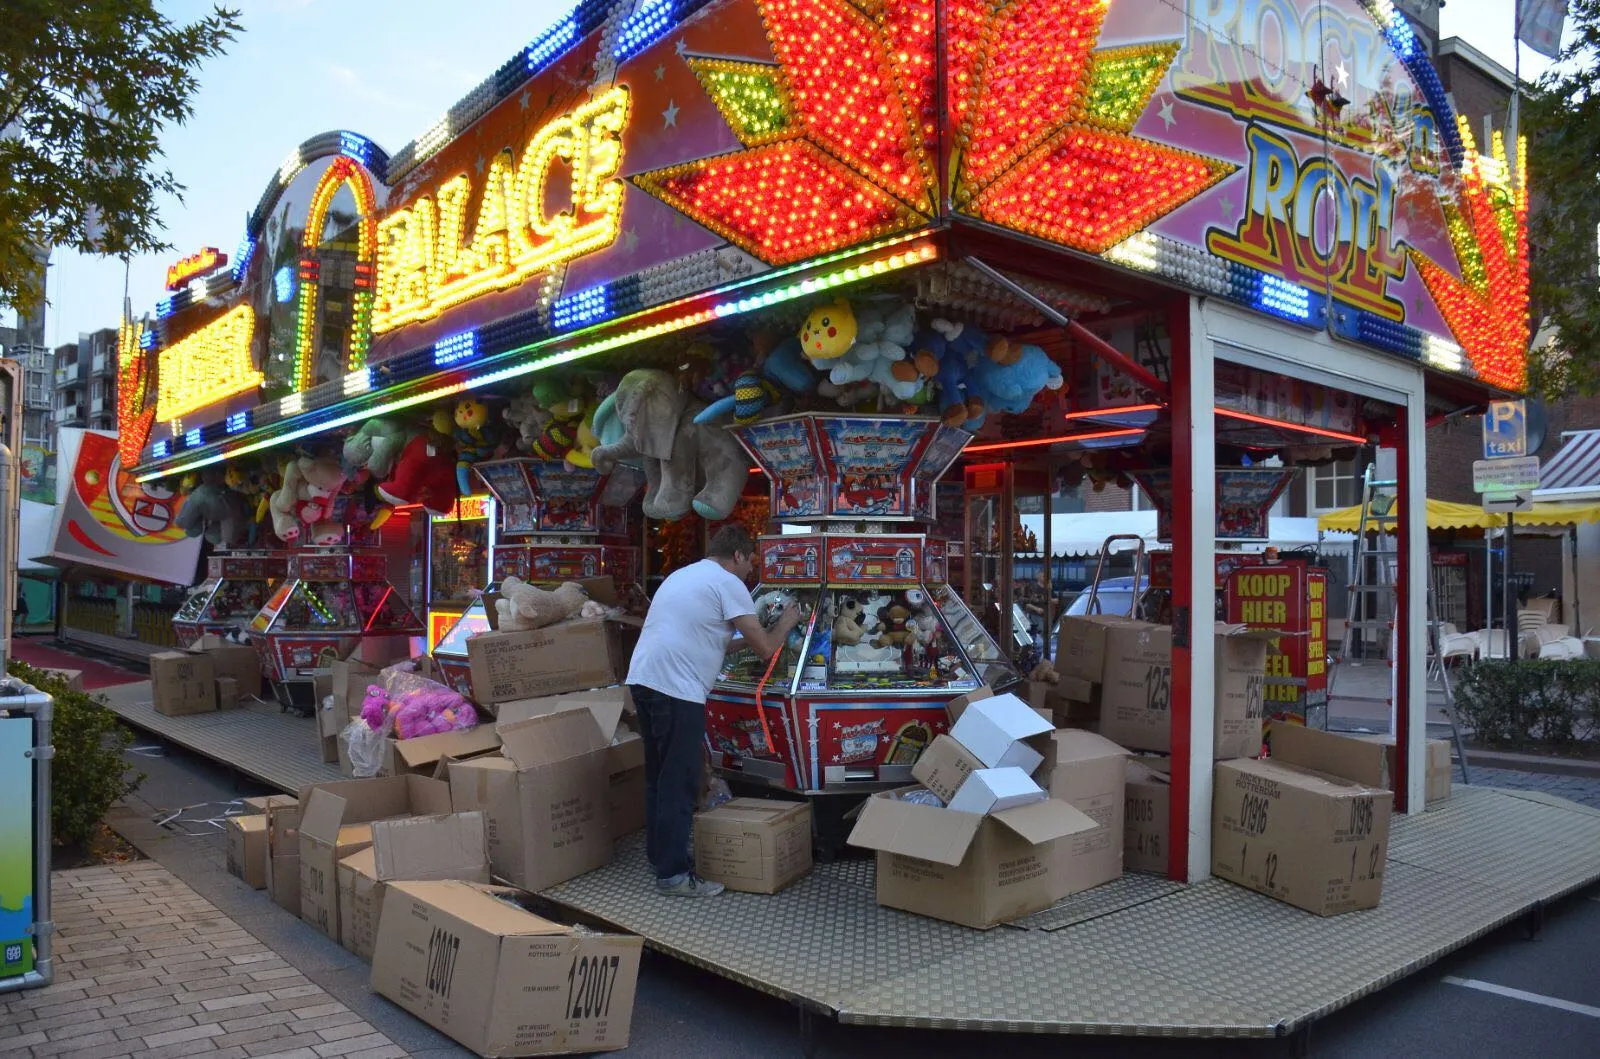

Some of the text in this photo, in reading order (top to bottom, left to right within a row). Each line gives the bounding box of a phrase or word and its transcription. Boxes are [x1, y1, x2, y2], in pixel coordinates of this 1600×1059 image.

[1181, 0, 1398, 148] ROCK
[372, 84, 631, 330] PALACE
[1228, 123, 1407, 305] ROLL
[1492, 402, 1515, 433] P
[1489, 438, 1523, 454] taxi
[1237, 575, 1291, 597] KOOP
[1242, 601, 1287, 623] HIER
[1264, 655, 1292, 678] EEL
[1236, 780, 1281, 800] ROTTERDAM
[1265, 852, 1278, 889] 12
[425, 925, 460, 999] 12007
[565, 955, 620, 1019] 12007
